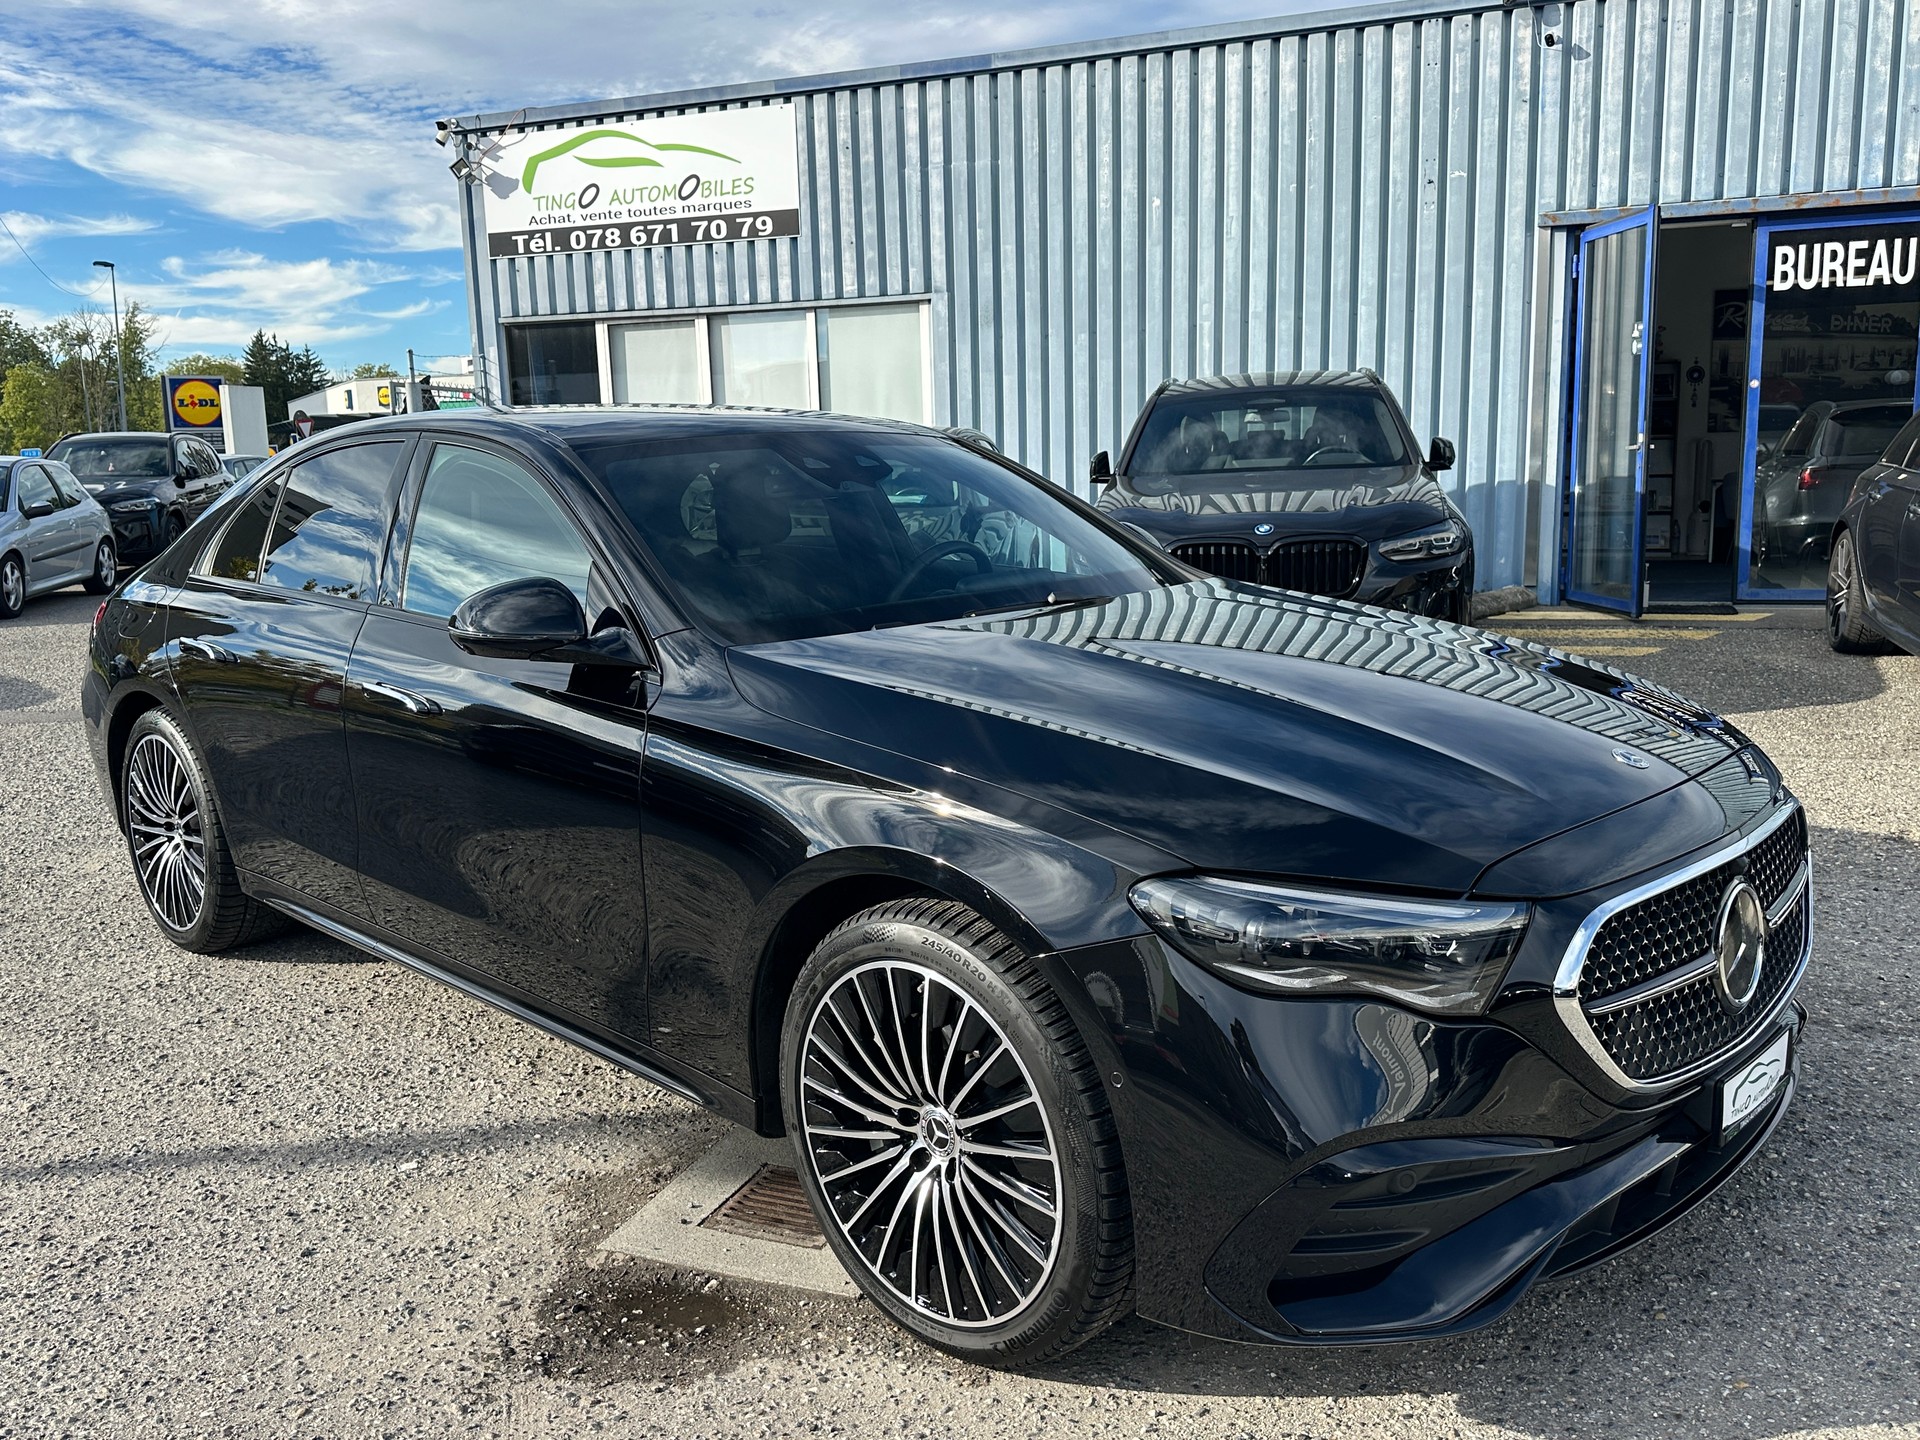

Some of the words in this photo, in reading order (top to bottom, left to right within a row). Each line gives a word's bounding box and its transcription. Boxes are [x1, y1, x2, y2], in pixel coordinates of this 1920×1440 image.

[533, 183, 600, 212] TINGO
[608, 174, 755, 206] AUTOMOBILES
[529, 213, 576, 227] Achat,
[580, 209, 623, 222] vente
[627, 204, 677, 219] toutes
[682, 199, 752, 215] marques
[512, 233, 561, 254] Tél.
[569, 228, 622, 250] 078
[629, 223, 679, 246] 671
[691, 219, 728, 241] 70
[735, 215, 773, 237] 79
[1773, 236, 1918, 291] BUREAU
